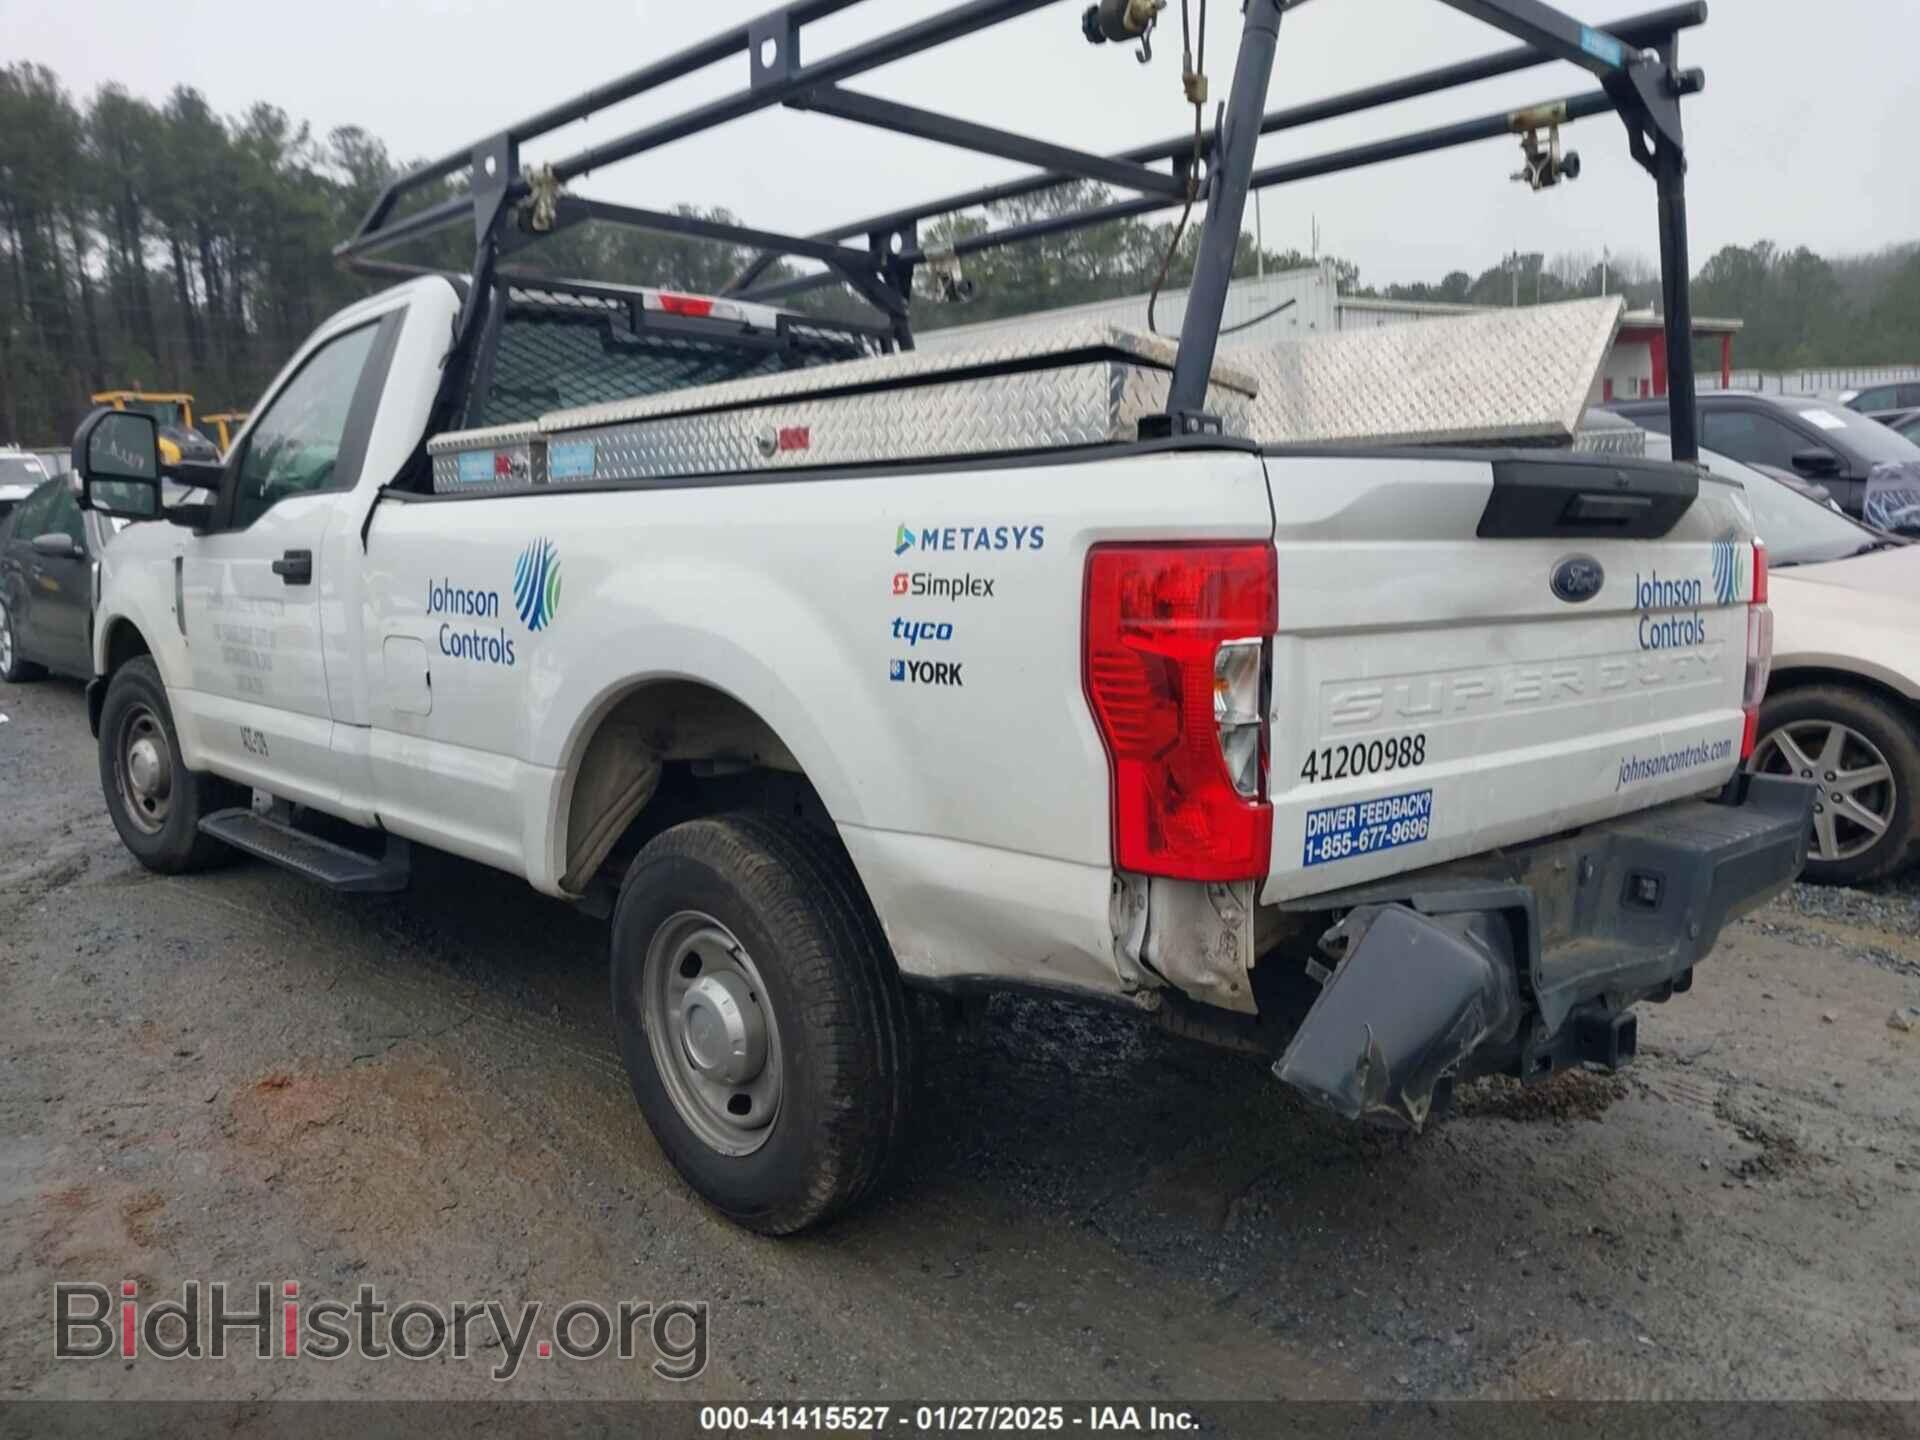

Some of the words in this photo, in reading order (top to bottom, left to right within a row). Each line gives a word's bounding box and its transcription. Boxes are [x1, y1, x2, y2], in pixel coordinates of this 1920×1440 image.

[920, 525, 1045, 551] METASYS
[426, 576, 499, 618] Johnson
[911, 572, 995, 602] Simplex
[1567, 564, 1601, 592] Ford
[1635, 568, 1702, 610] Johnson
[439, 622, 516, 666] Controls
[891, 616, 953, 646] tyco
[1638, 611, 1705, 650] Controls
[908, 660, 964, 687] YORK
[1330, 666, 1585, 727] SUPER
[1600, 649, 1721, 691] DUTY
[1300, 733, 1426, 784] 41200988
[1614, 738, 1733, 792] johnsoncontrols.com
[1307, 806, 1356, 838] DRIVER
[1359, 792, 1431, 827] FEEDBACK?
[1306, 817, 1429, 863] 1-855-677-9696
